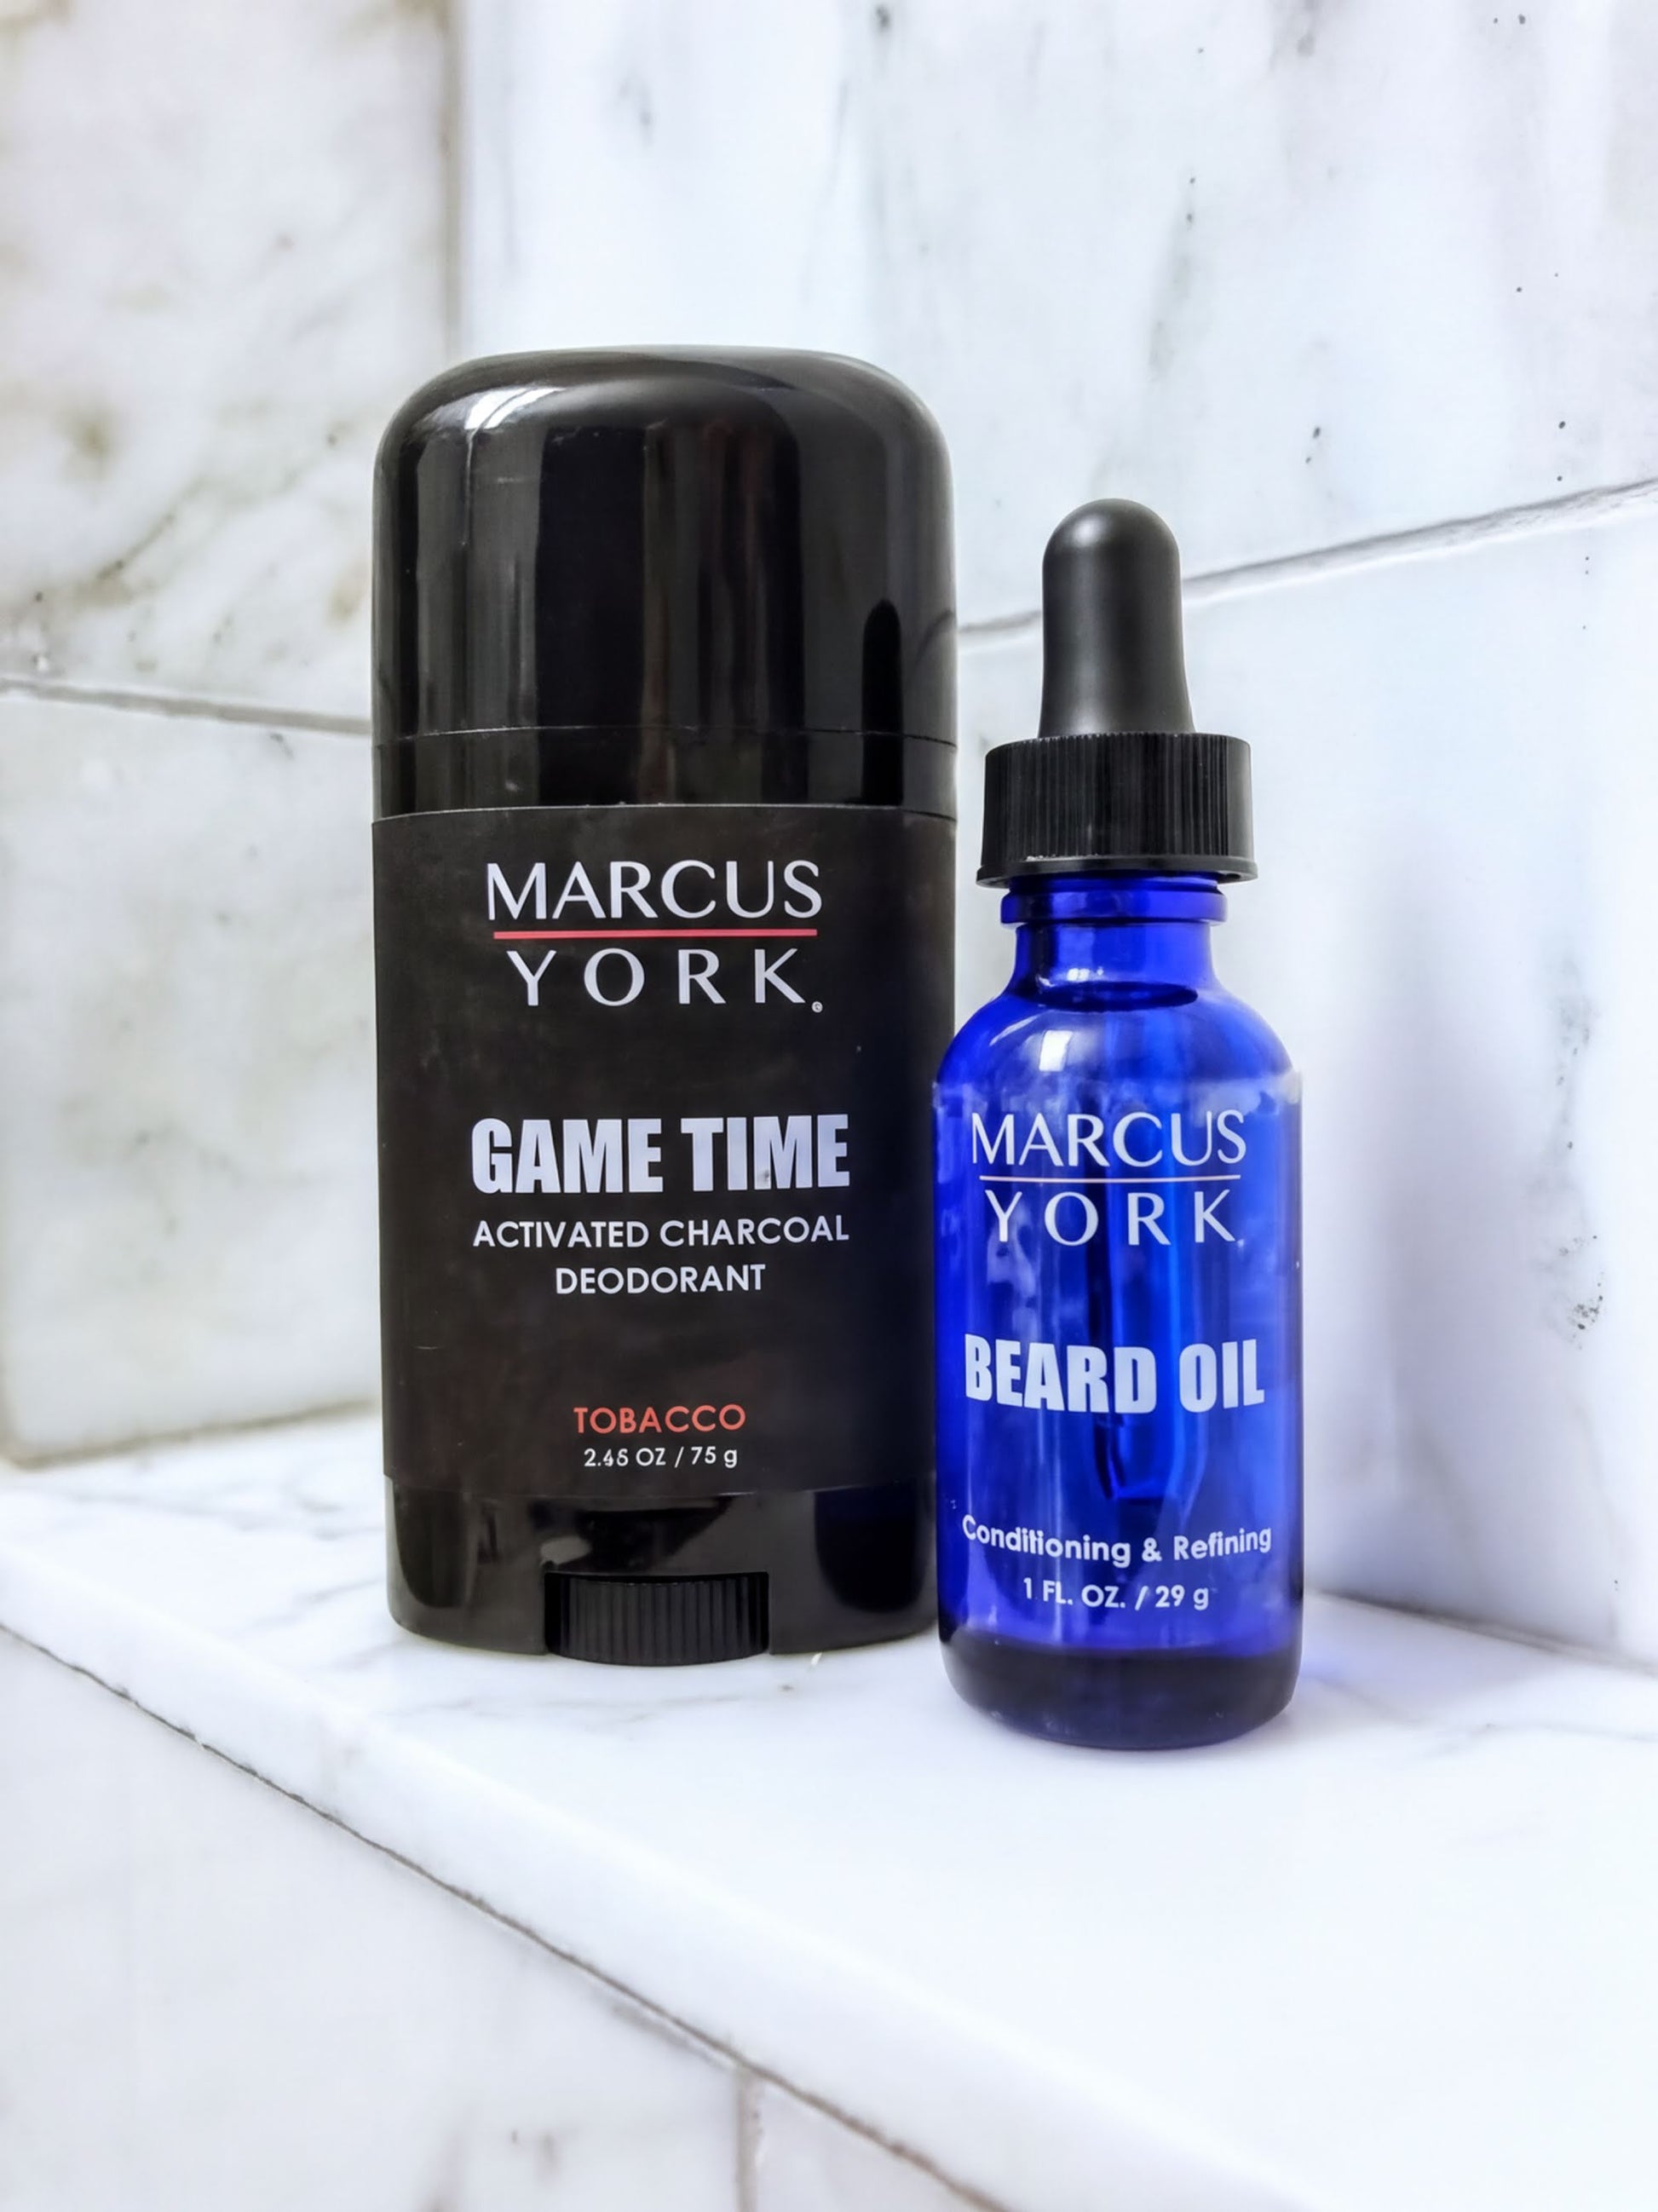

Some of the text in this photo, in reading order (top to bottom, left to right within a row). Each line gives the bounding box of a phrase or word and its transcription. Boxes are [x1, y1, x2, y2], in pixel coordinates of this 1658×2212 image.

[486, 860, 822, 920] MARCUS
[471, 1114, 850, 1194] GAME TIME
[971, 1109, 1246, 1167] MARCUS
[473, 1215, 849, 1249] ACTIVATED CHARCOAL
[556, 1264, 766, 1294] DEODORANT
[964, 1333, 1265, 1414] BEARD OIL
[573, 1403, 746, 1435] TOBACCO
[636, 1448, 665, 1467] OZ
[674, 1448, 685, 1468] /
[691, 1446, 717, 1466] 75
[723, 1449, 739, 1468] g
[962, 1514, 1273, 1568] Conditioning & Refining
[1023, 1577, 1210, 1610] 1 FL. OZ. / 29 g
